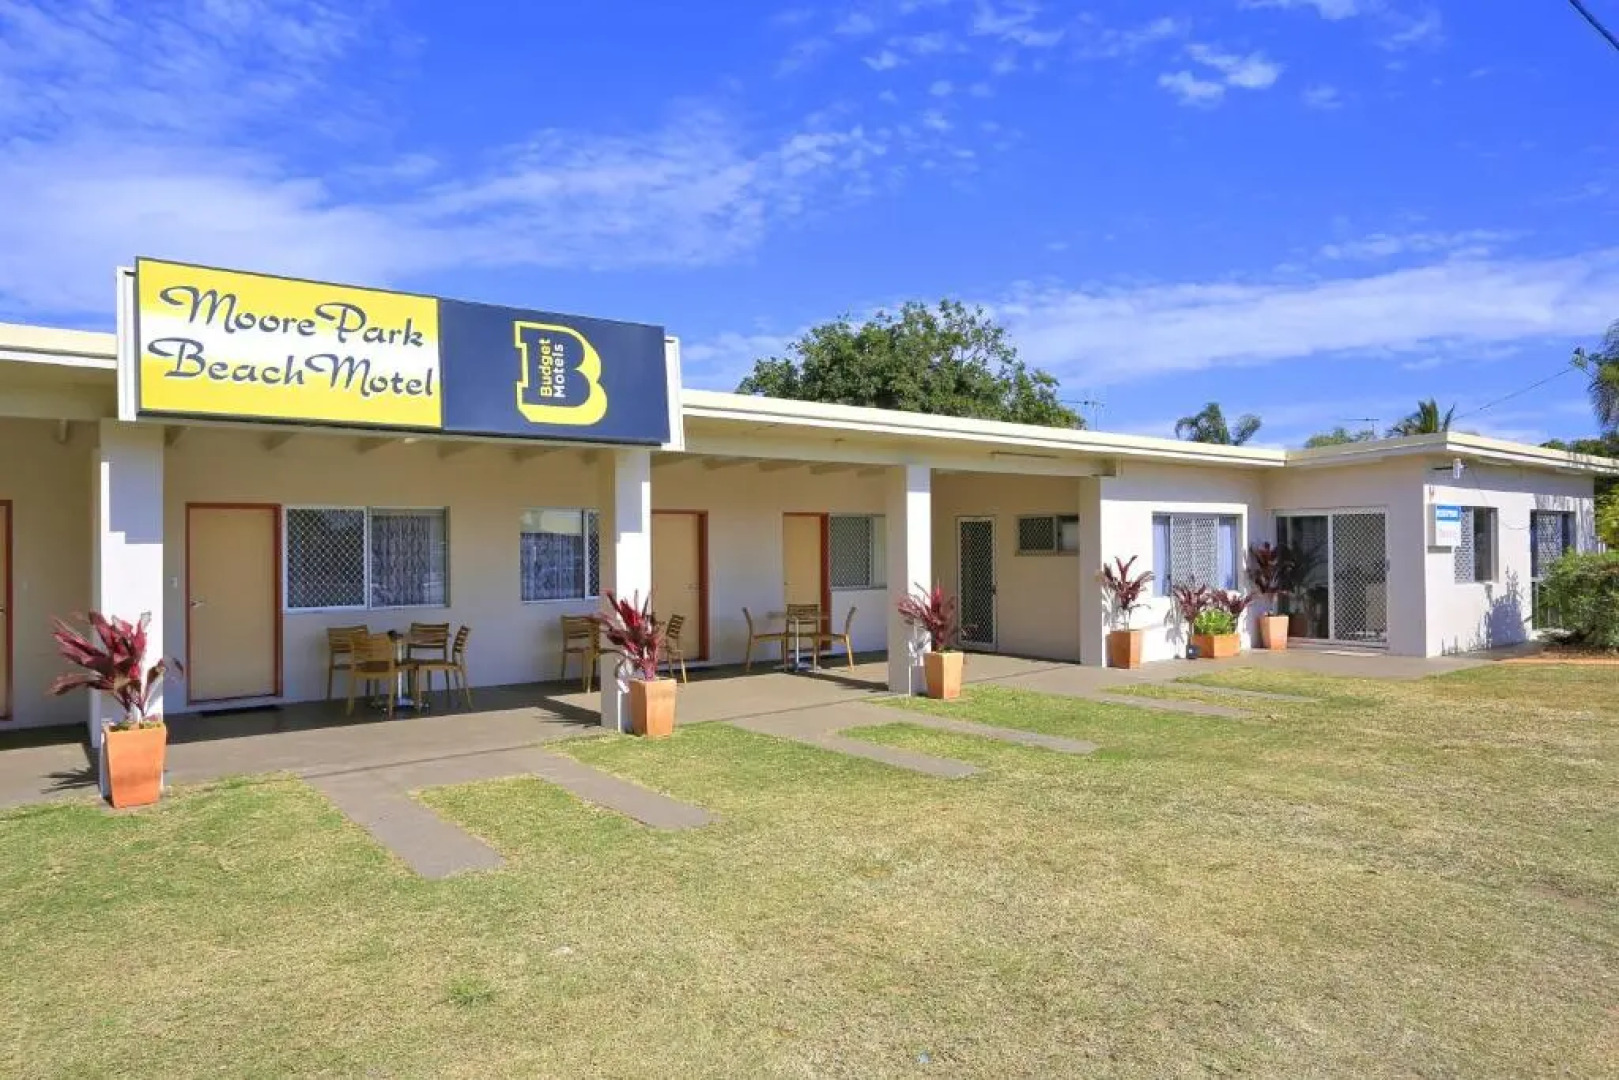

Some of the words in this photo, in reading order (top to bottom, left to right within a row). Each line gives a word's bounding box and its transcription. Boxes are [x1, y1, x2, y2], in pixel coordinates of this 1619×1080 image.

[160, 286, 316, 336] Moore
[314, 302, 423, 347] Park
[147, 337, 304, 385] Beach
[305, 353, 433, 397] Motel
[539, 338, 553, 397] Budget
[552, 342, 566, 398] Motels
